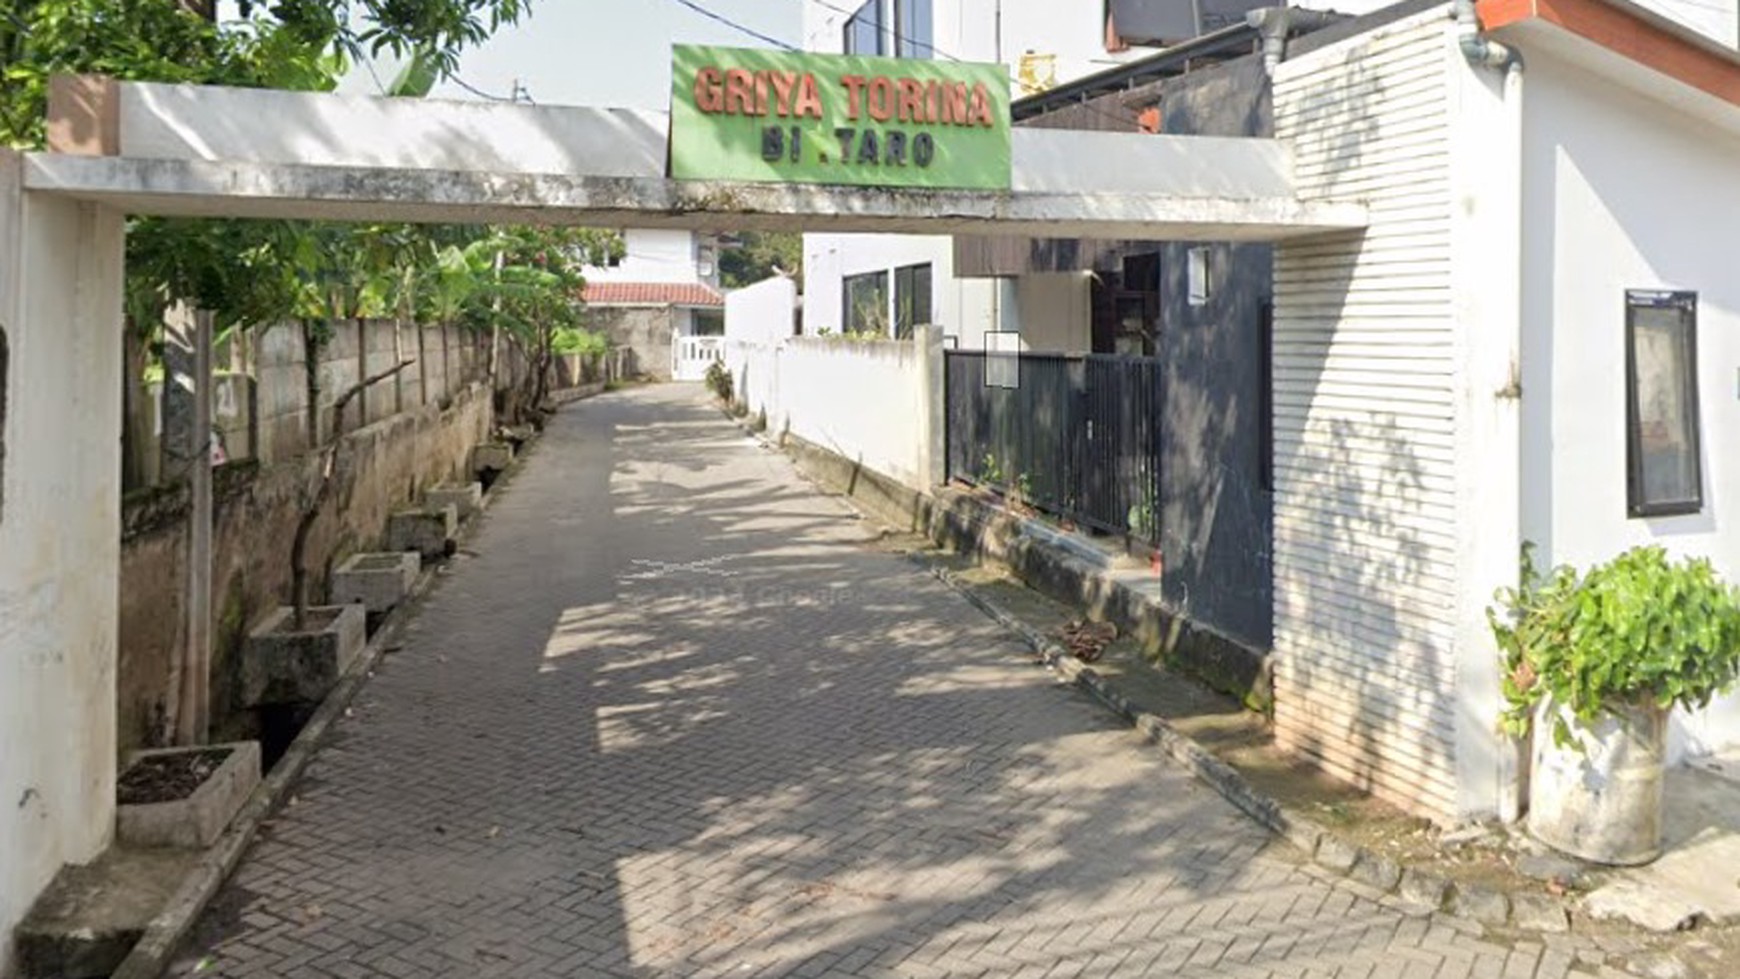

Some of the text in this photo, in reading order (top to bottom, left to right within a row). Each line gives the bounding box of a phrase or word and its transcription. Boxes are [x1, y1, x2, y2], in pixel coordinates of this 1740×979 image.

[694, 67, 995, 127] GRIYA TORINA
[761, 125, 936, 167] BITARO
